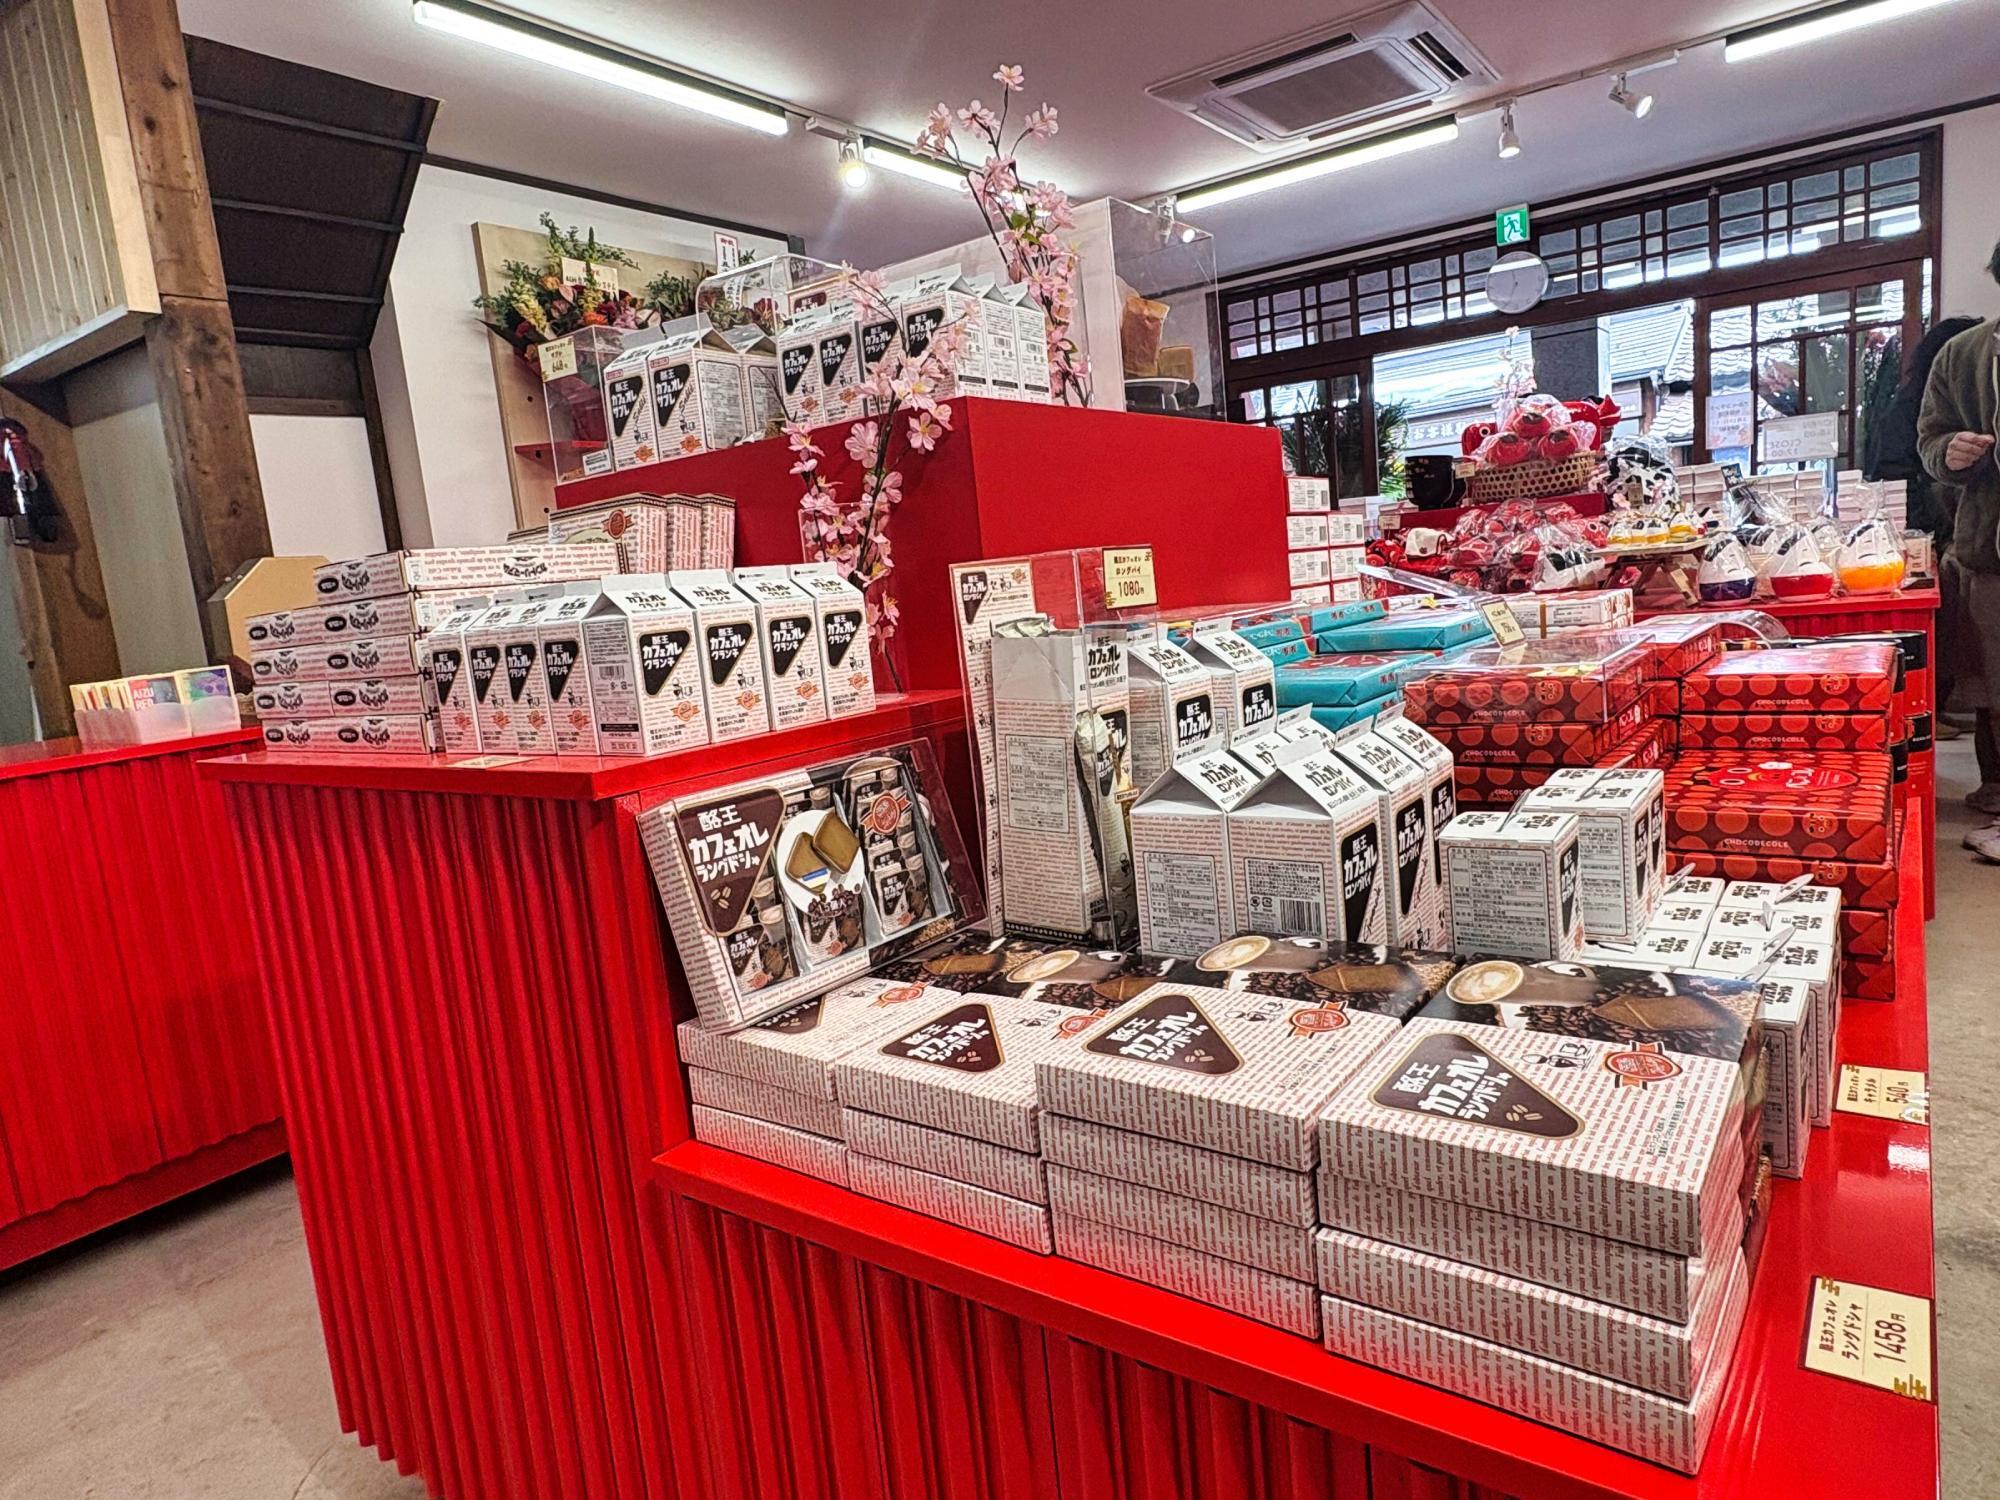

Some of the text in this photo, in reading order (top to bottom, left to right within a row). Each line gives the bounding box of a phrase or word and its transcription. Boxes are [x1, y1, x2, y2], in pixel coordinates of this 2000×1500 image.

[909, 320, 937, 332] カフェオレ
[656, 378, 684, 393] カフェオレ
[612, 389, 637, 406] カフェオレ
[962, 581, 987, 593] カフェオレ
[1118, 580, 1144, 598] 1080円
[718, 627, 734, 636] 酪王
[772, 627, 806, 642] カフェオレ
[780, 621, 794, 629] 酪王
[826, 620, 857, 634] カフェオレ
[652, 635, 669, 645] 酪王
[709, 635, 746, 651] カフェオレ
[773, 640, 800, 652] クランチ
[828, 632, 852, 645] クランチ
[642, 642, 683, 660] カフェオレ
[644, 654, 676, 670] クランチ
[711, 649, 741, 661] クランチ
[1088, 644, 1121, 667] カフェオレ
[1090, 662, 1120, 680] ロングパイ
[1244, 701, 1273, 726] カフェオレ
[1179, 714, 1211, 736] カフェオレ
[1362, 744, 1392, 766] カフェオレ
[1200, 762, 1239, 785] カフェオレ
[1216, 775, 1250, 794] ロングパイ
[1306, 763, 1344, 787] カフェオレ
[1323, 777, 1355, 797] ロングパイ
[697, 804, 742, 832] 酪王
[688, 821, 770, 865] カフェオレ
[1398, 818, 1425, 852] カフェオレ
[695, 850, 760, 883] ラングドシャ
[1343, 844, 1377, 883] カフェオレ
[1399, 843, 1420, 869] ロングパイ
[1344, 875, 1372, 900] ロングパイ
[730, 937, 757, 953] カフェオレ
[901, 1024, 950, 1046] 酪王
[906, 1018, 987, 1061] カフェオレ
[1106, 1016, 1155, 1042] 酪王
[1119, 1011, 1198, 1058] カフェオレ
[927, 1030, 991, 1062] ラングドシャ
[1147, 1025, 1210, 1063] ラングドシャ
[1392, 1061, 1441, 1094] 酪王
[1417, 1054, 1490, 1116] カフェオレ
[1457, 1072, 1513, 1120] ラングドシャ
[1819, 1300, 1838, 1352] 酪王カフェオレ
[1842, 1303, 1863, 1360] ラングドシャ
[1873, 1313, 1907, 1363] 1458円
